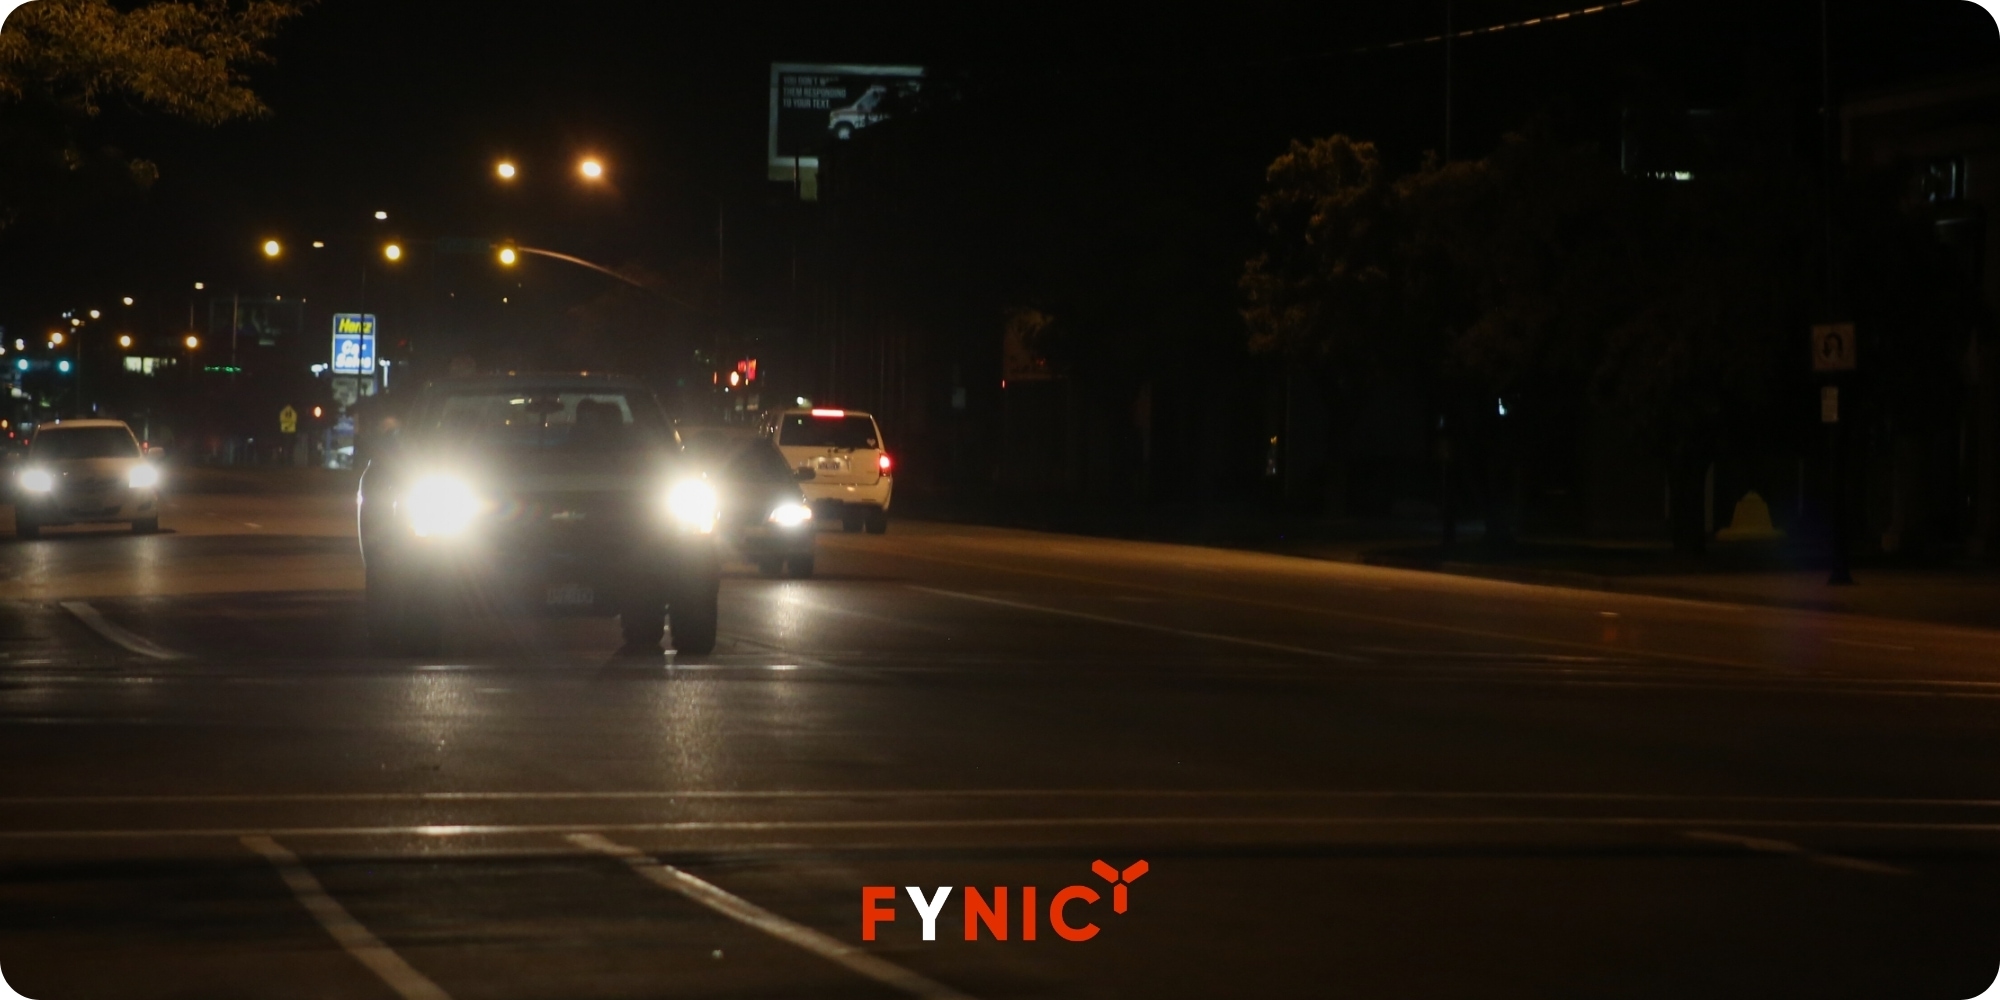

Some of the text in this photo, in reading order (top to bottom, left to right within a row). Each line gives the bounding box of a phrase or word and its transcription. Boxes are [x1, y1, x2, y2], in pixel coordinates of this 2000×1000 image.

[783, 87, 846, 98] THEM RESPONDING
[783, 98, 792, 108] TO
[793, 98, 811, 108] YOUR
